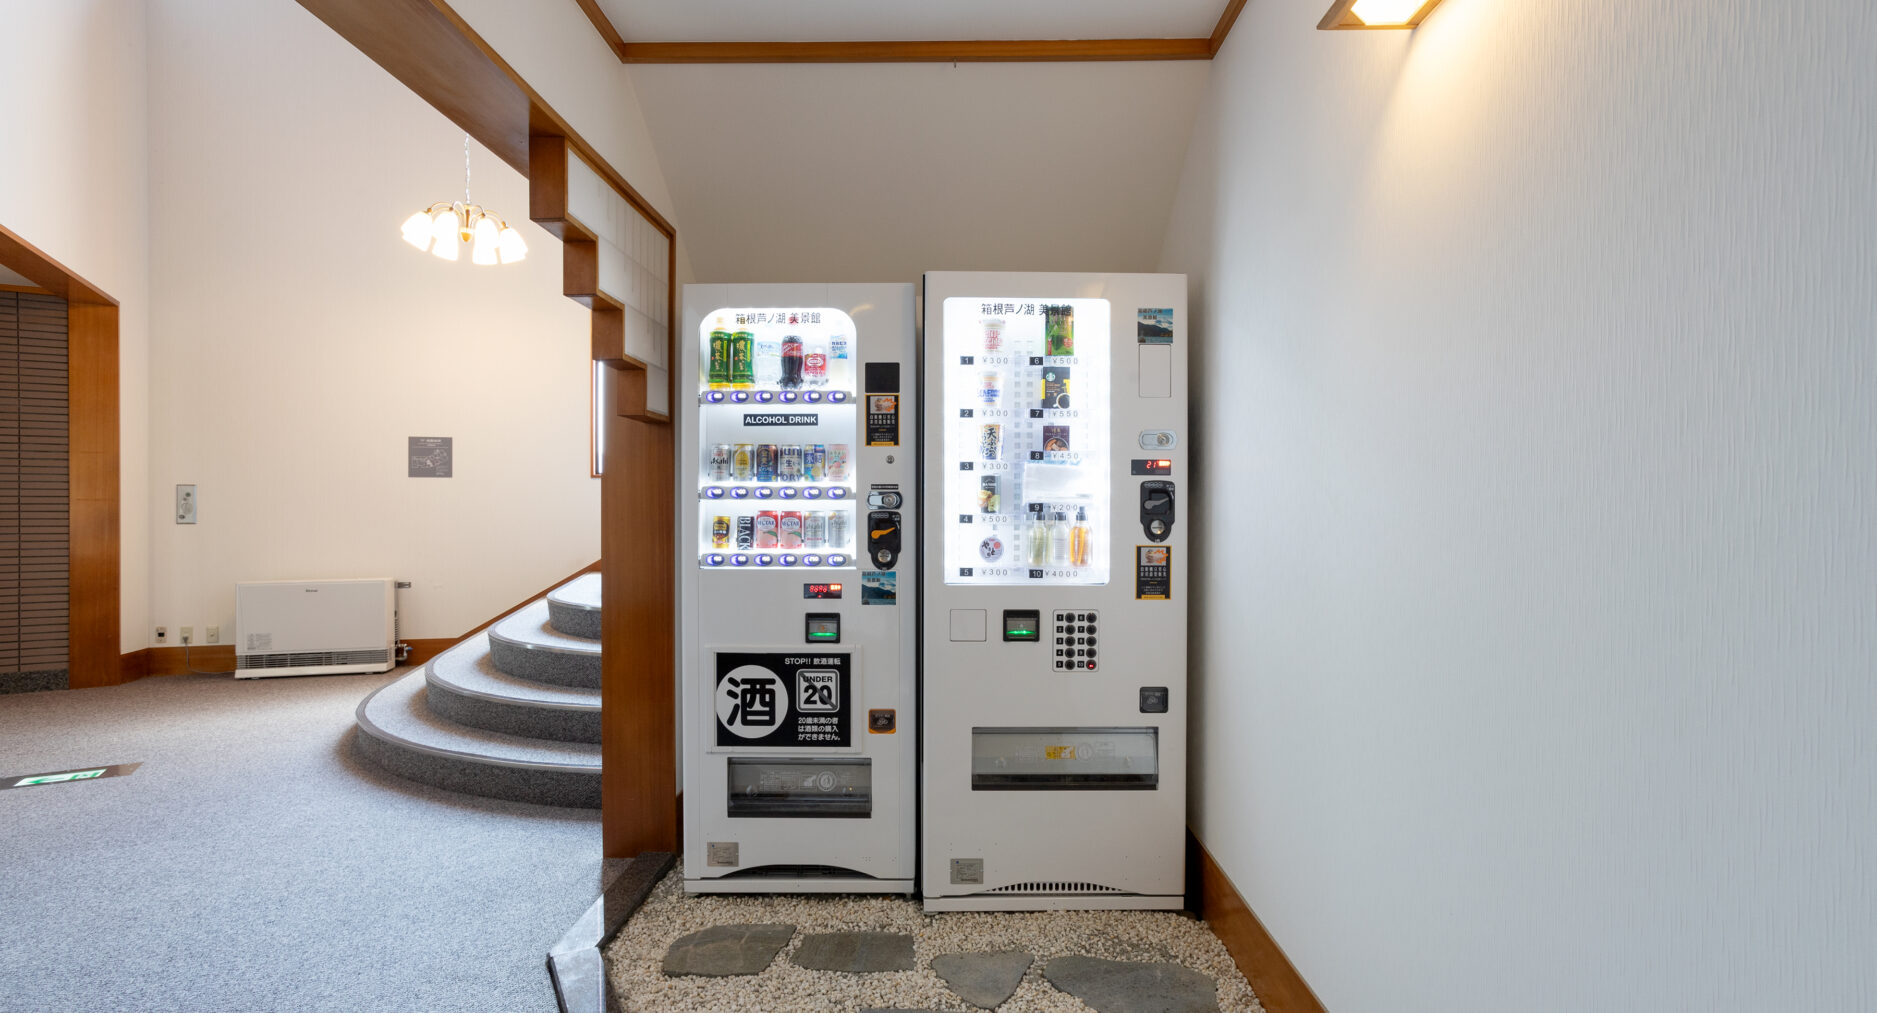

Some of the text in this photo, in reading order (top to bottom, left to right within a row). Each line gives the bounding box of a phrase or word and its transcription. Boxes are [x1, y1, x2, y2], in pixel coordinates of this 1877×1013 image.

[736, 312, 821, 324] 箱根芦ノ湖 美景館
[981, 303, 1035, 316] 箱根芦ノ湖
[740, 517, 751, 550] BLACK
[726, 677, 776, 726] 酒
[804, 685, 832, 705] 20
